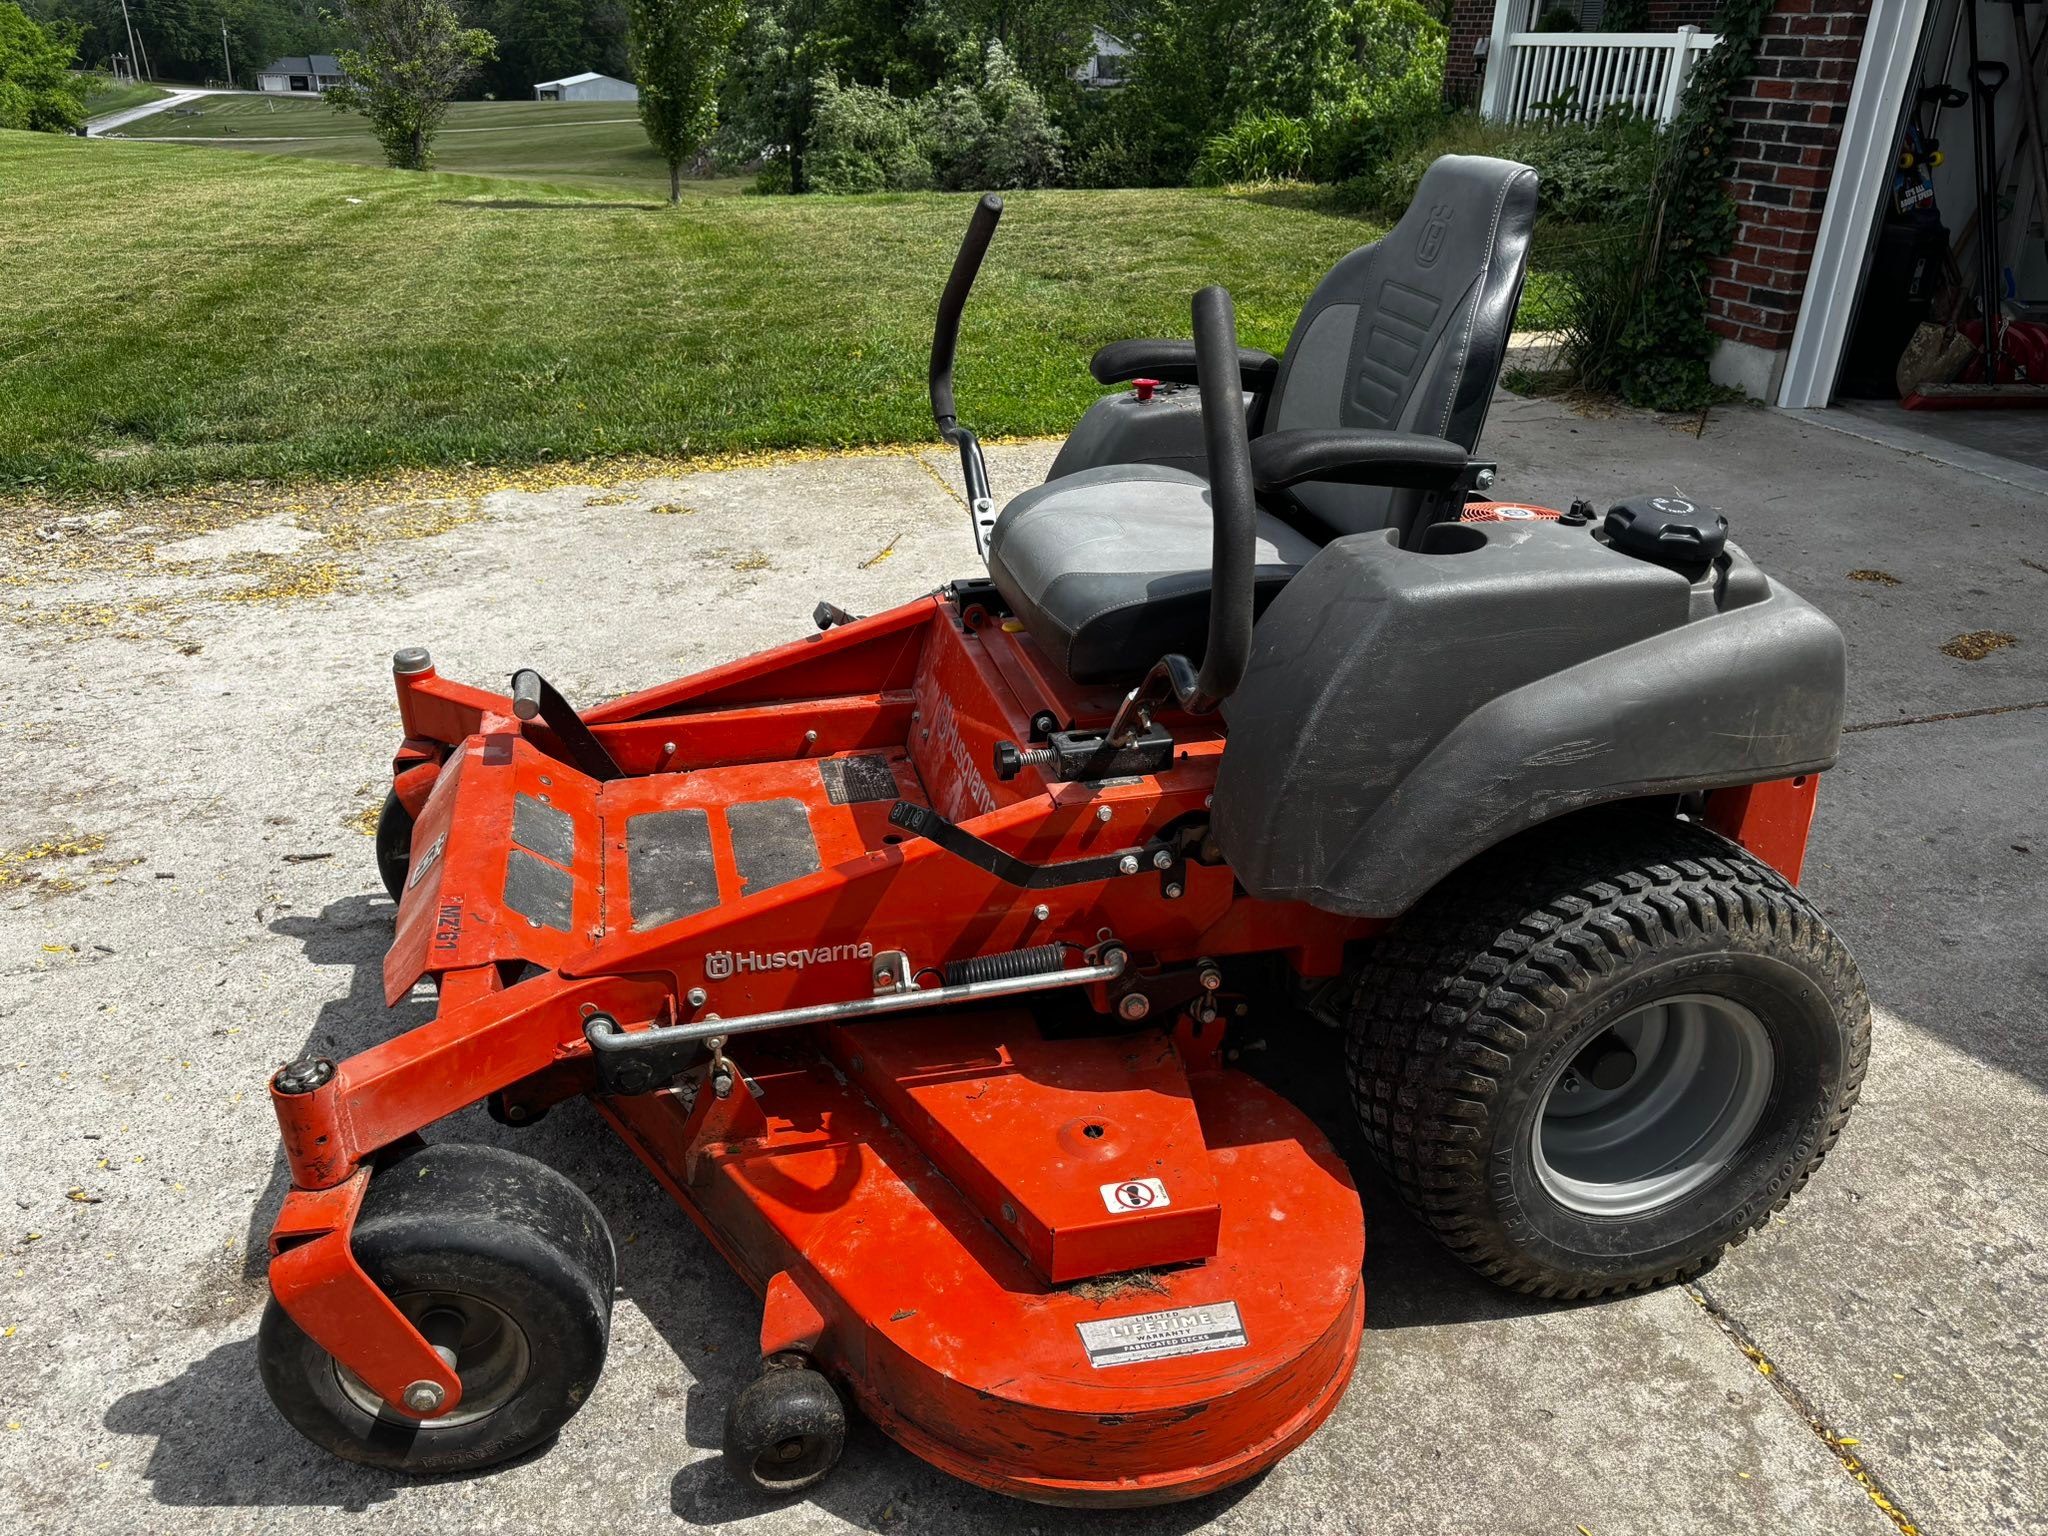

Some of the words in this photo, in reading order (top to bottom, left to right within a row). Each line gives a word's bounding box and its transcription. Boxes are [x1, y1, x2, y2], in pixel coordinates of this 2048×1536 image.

[945, 712, 997, 814] Husqvarna
[736, 942, 873, 972] Husqvarna
[1493, 1148, 1540, 1248] KENDA
[1110, 1313, 1212, 1338] LIFETIME
[1135, 1311, 1179, 1322] LIMITED
[1124, 1339, 1179, 1351] FABRICATED
[1180, 1334, 1210, 1343] DECKS
[1136, 1329, 1191, 1341] WARRANTY
